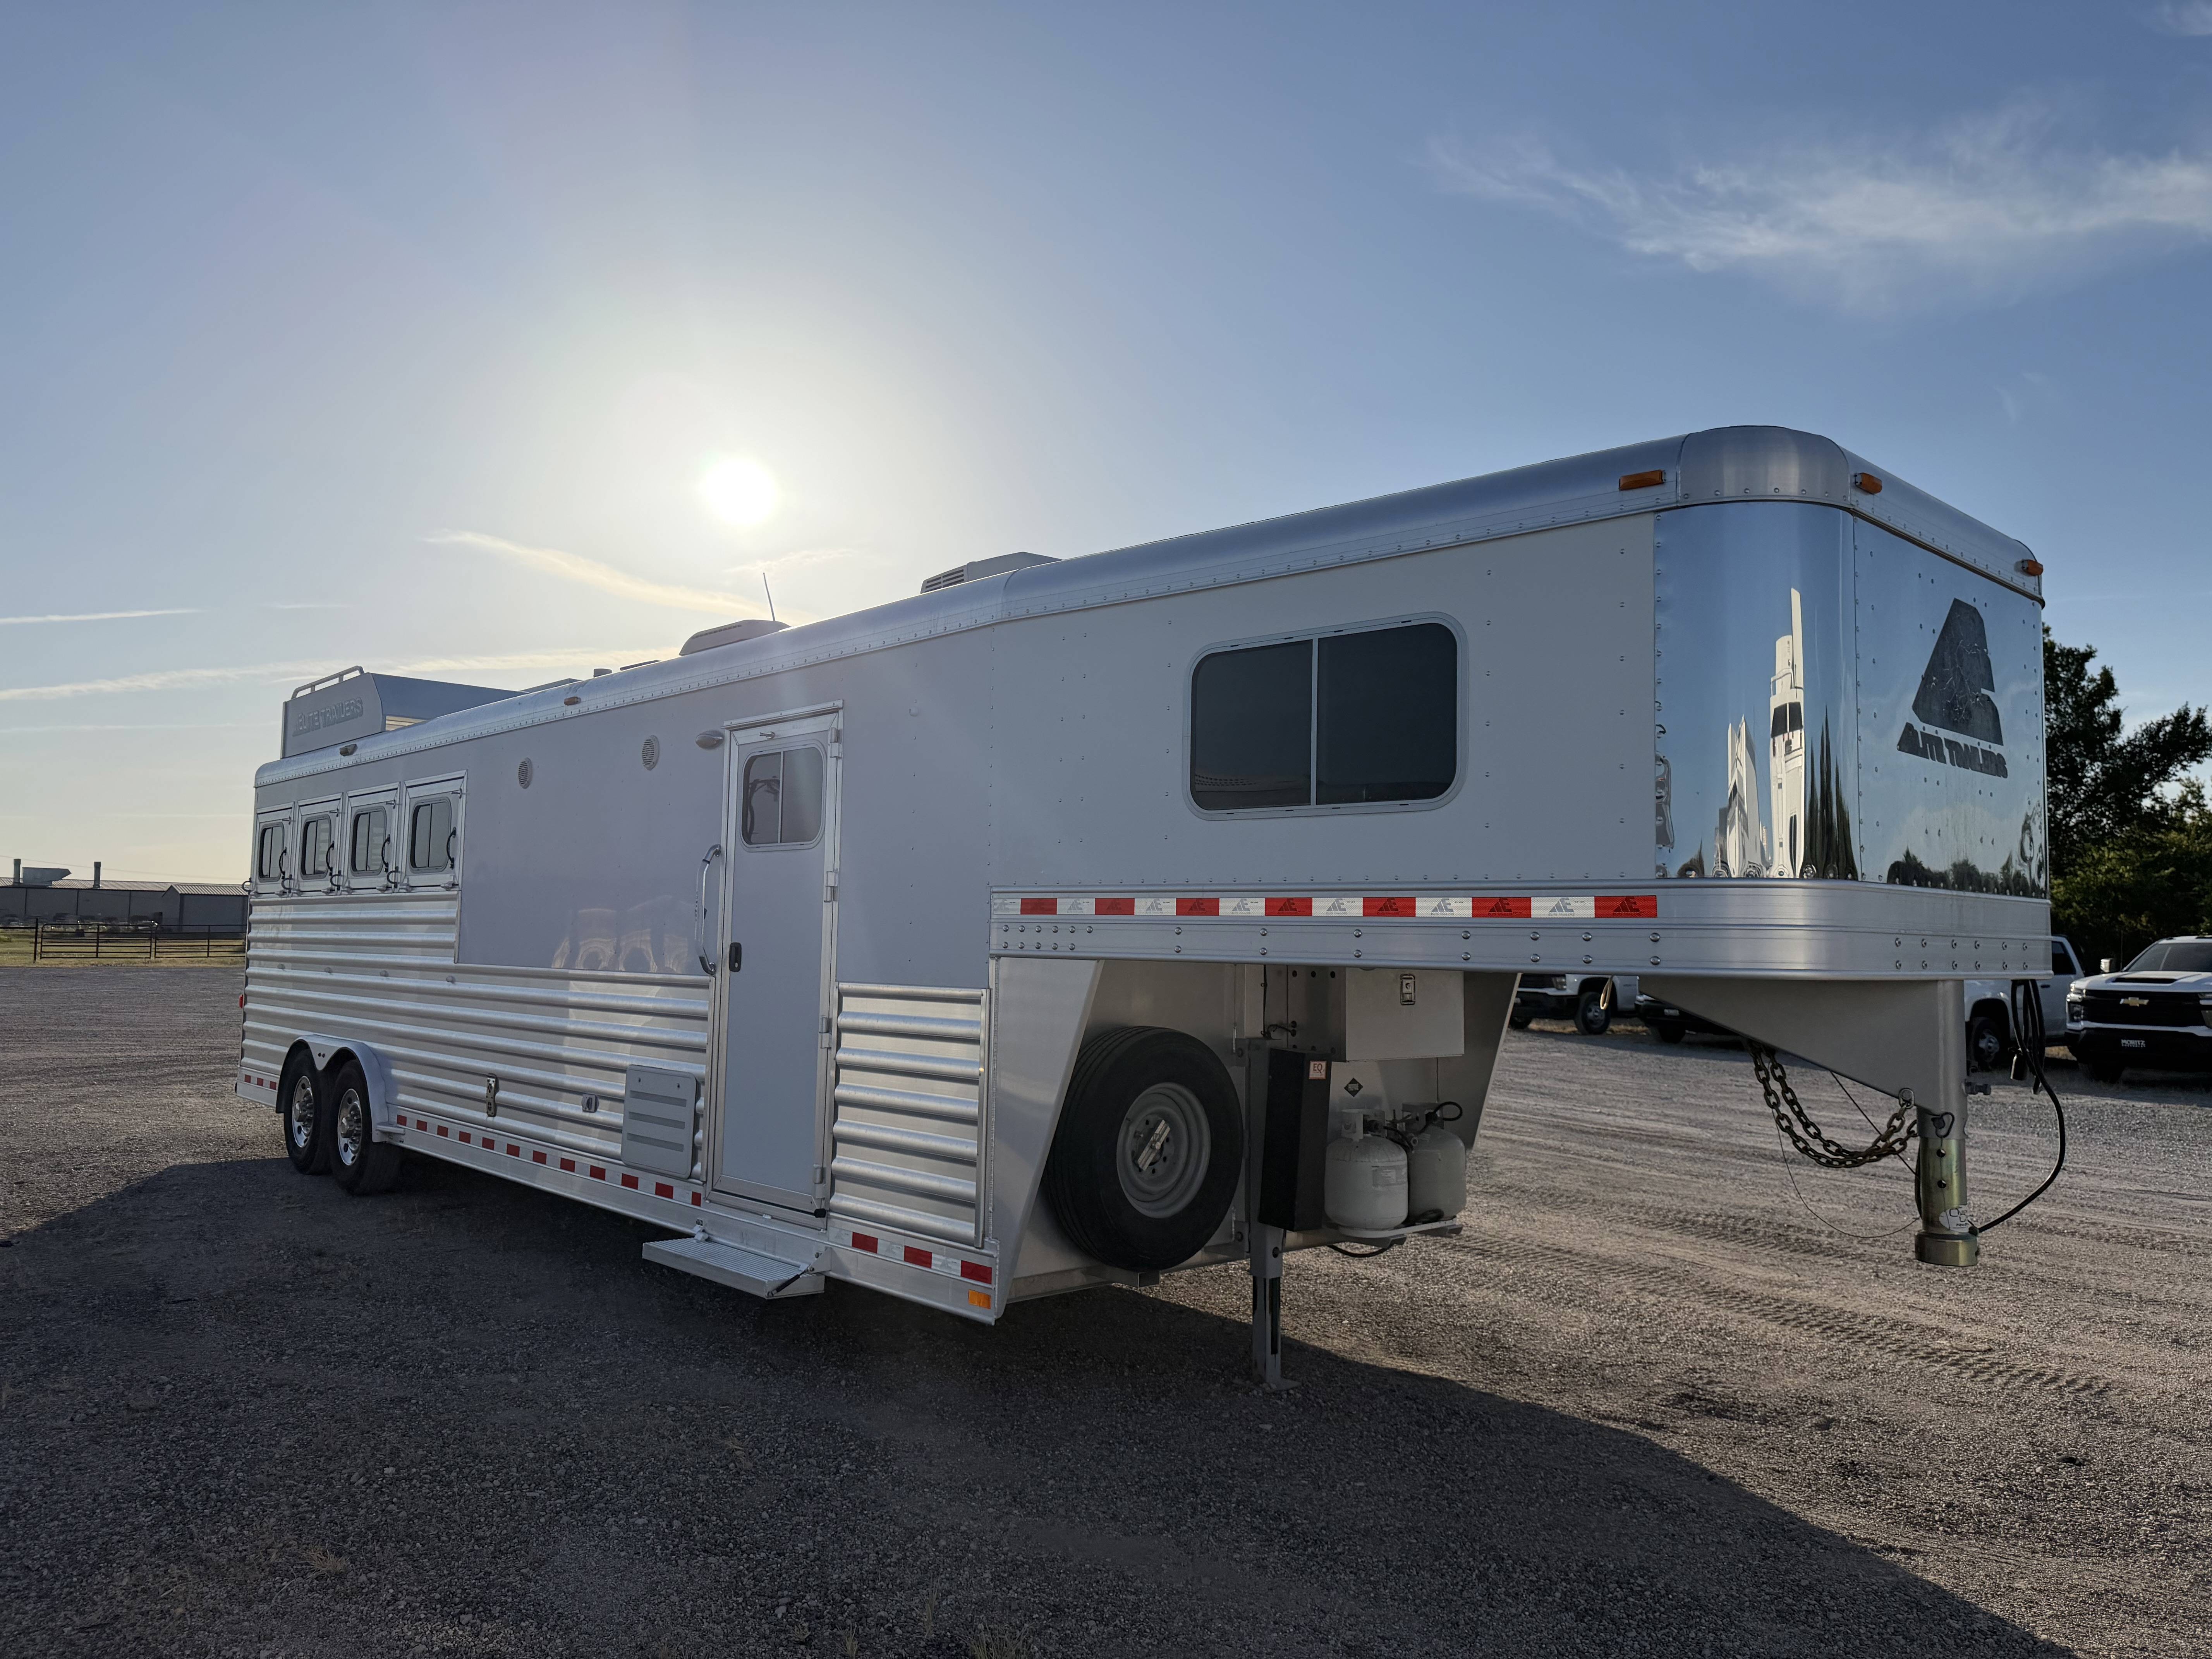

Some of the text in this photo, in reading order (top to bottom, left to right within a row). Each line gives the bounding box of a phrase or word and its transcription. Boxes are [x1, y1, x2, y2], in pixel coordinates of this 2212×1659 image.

[295, 697, 363, 735] ELITE TRAILERS
[1313, 1063, 1322, 1073] EQ
